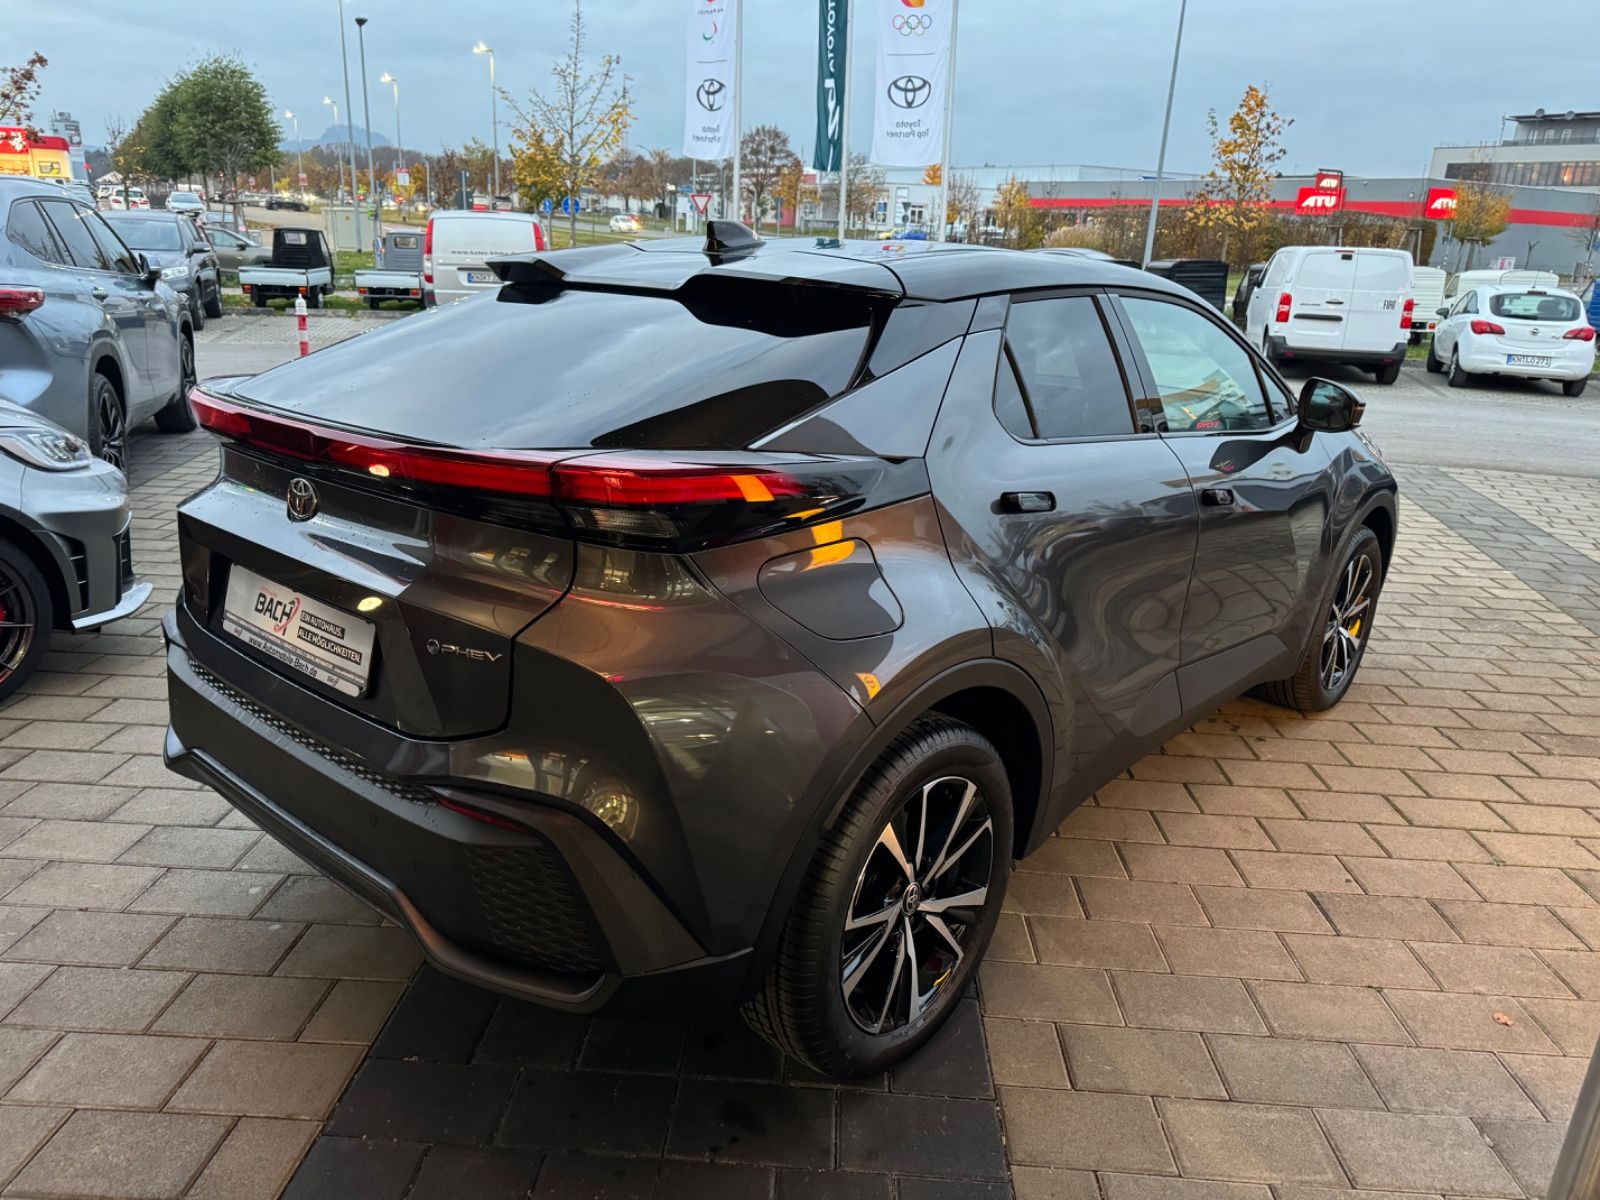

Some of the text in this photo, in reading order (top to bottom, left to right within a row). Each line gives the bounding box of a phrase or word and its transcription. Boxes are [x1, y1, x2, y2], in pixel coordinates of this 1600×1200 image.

[1319, 178, 1338, 188] ATU
[1301, 195, 1336, 207] ATU
[255, 592, 294, 632] BACH
[441, 644, 503, 662] PHEV
